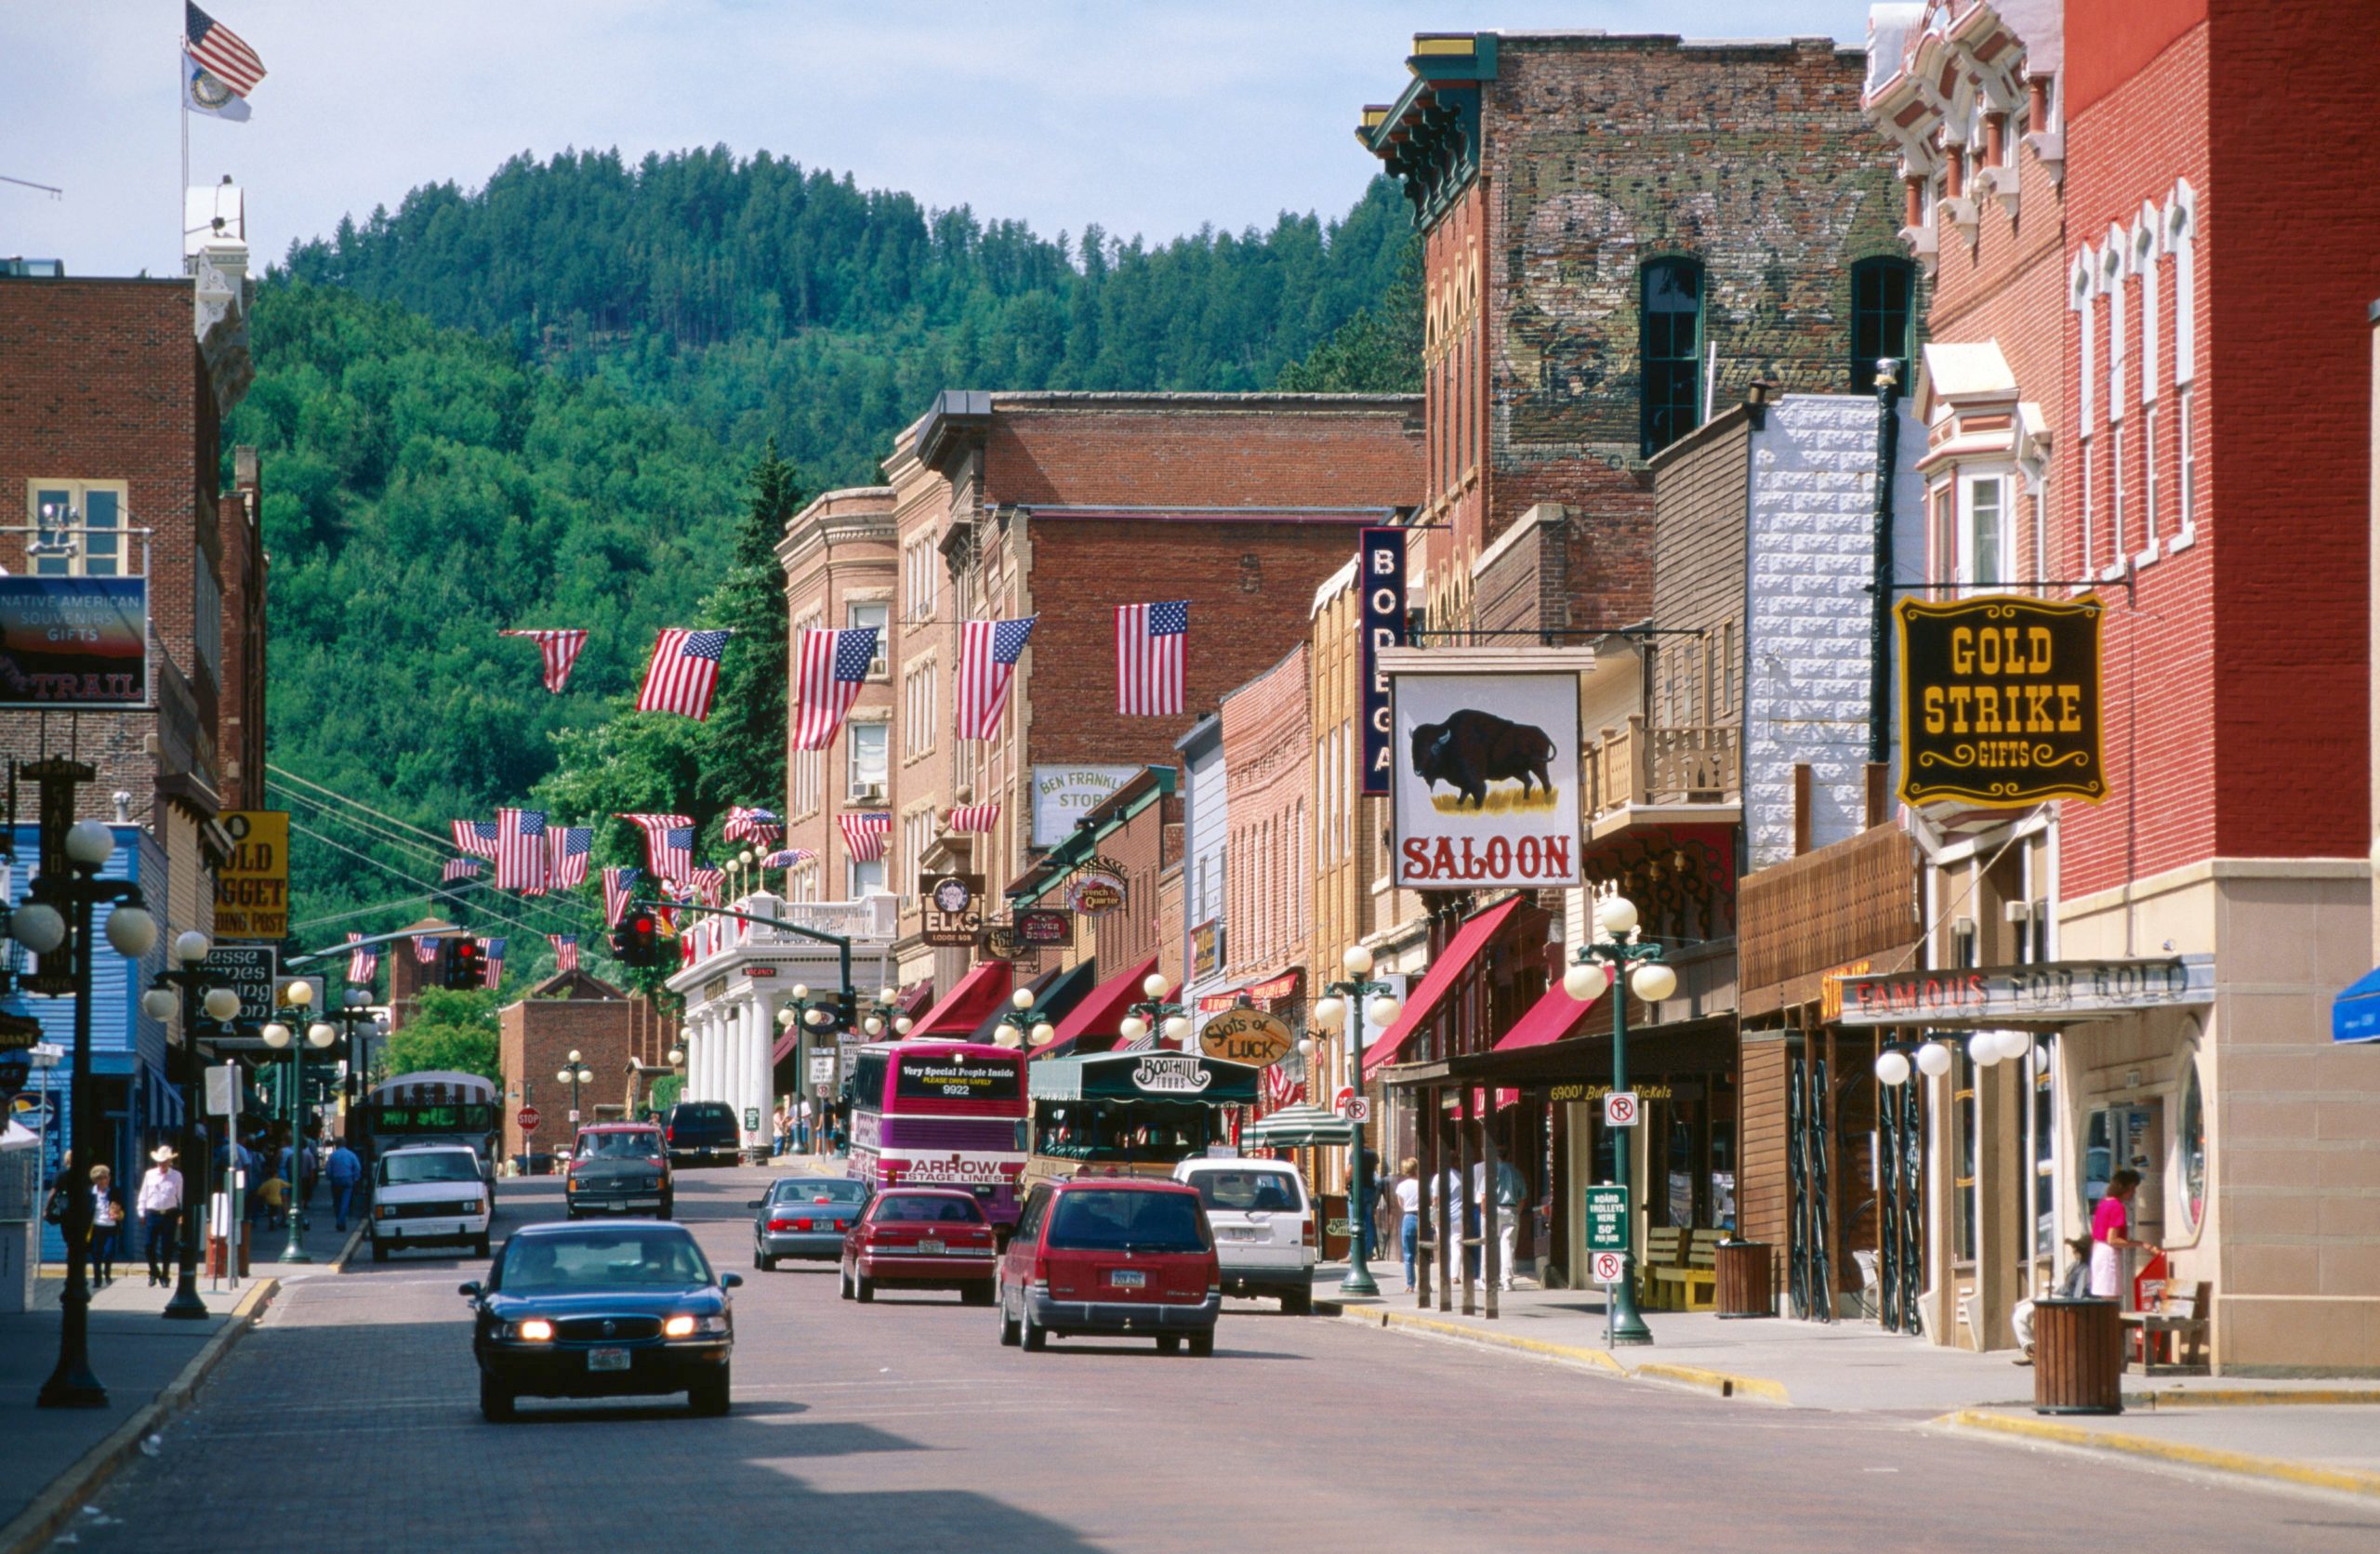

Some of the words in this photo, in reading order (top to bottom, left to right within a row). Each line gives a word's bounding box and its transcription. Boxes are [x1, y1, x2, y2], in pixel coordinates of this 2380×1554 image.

[0, 594, 56, 608] NATIVE
[60, 595, 139, 608] AMERICAN
[20, 612, 114, 626] SOUVENIRS
[47, 628, 99, 641] GIFTS
[1952, 626, 2052, 675] GOLD
[30, 673, 143, 700] TRAIL
[1924, 684, 2082, 734] STRIKE
[1978, 741, 2030, 767] GIFTS
[1039, 774, 1065, 795] BEN
[1059, 794, 1107, 807] STOR
[1402, 835, 1573, 880] SALOON
[1081, 888, 1108, 896] French
[1085, 895, 1119, 908] Quarter
[251, 913, 284, 932] POST
[926, 912, 979, 931] ELKS
[1857, 974, 1985, 1012] FAMOUS
[2010, 968, 2073, 1002] FOR
[2094, 965, 2188, 999] GOLD
[1204, 1017, 1247, 1047] Slots
[1227, 1040, 1276, 1059] LUCK
[904, 1066, 922, 1076] Very
[925, 1066, 957, 1076] Special
[959, 1067, 985, 1077] People
[988, 1068, 1014, 1077] Inside
[1136, 1059, 1208, 1087] BOOTHILL
[922, 1076, 947, 1085] PLEASE
[970, 1077, 992, 1086] SAFELY
[1157, 1076, 1185, 1088] TOURS
[943, 1085, 969, 1095] 9922
[519, 1114, 538, 1124] STOP
[914, 1162, 998, 1175] ARROW
[907, 1173, 955, 1182] STAGE
[961, 1174, 1003, 1183] LINES
[1594, 1194, 1619, 1204] BOARD
[1590, 1204, 1625, 1213] TROLLEYS
[1596, 1214, 1616, 1222] HERE
